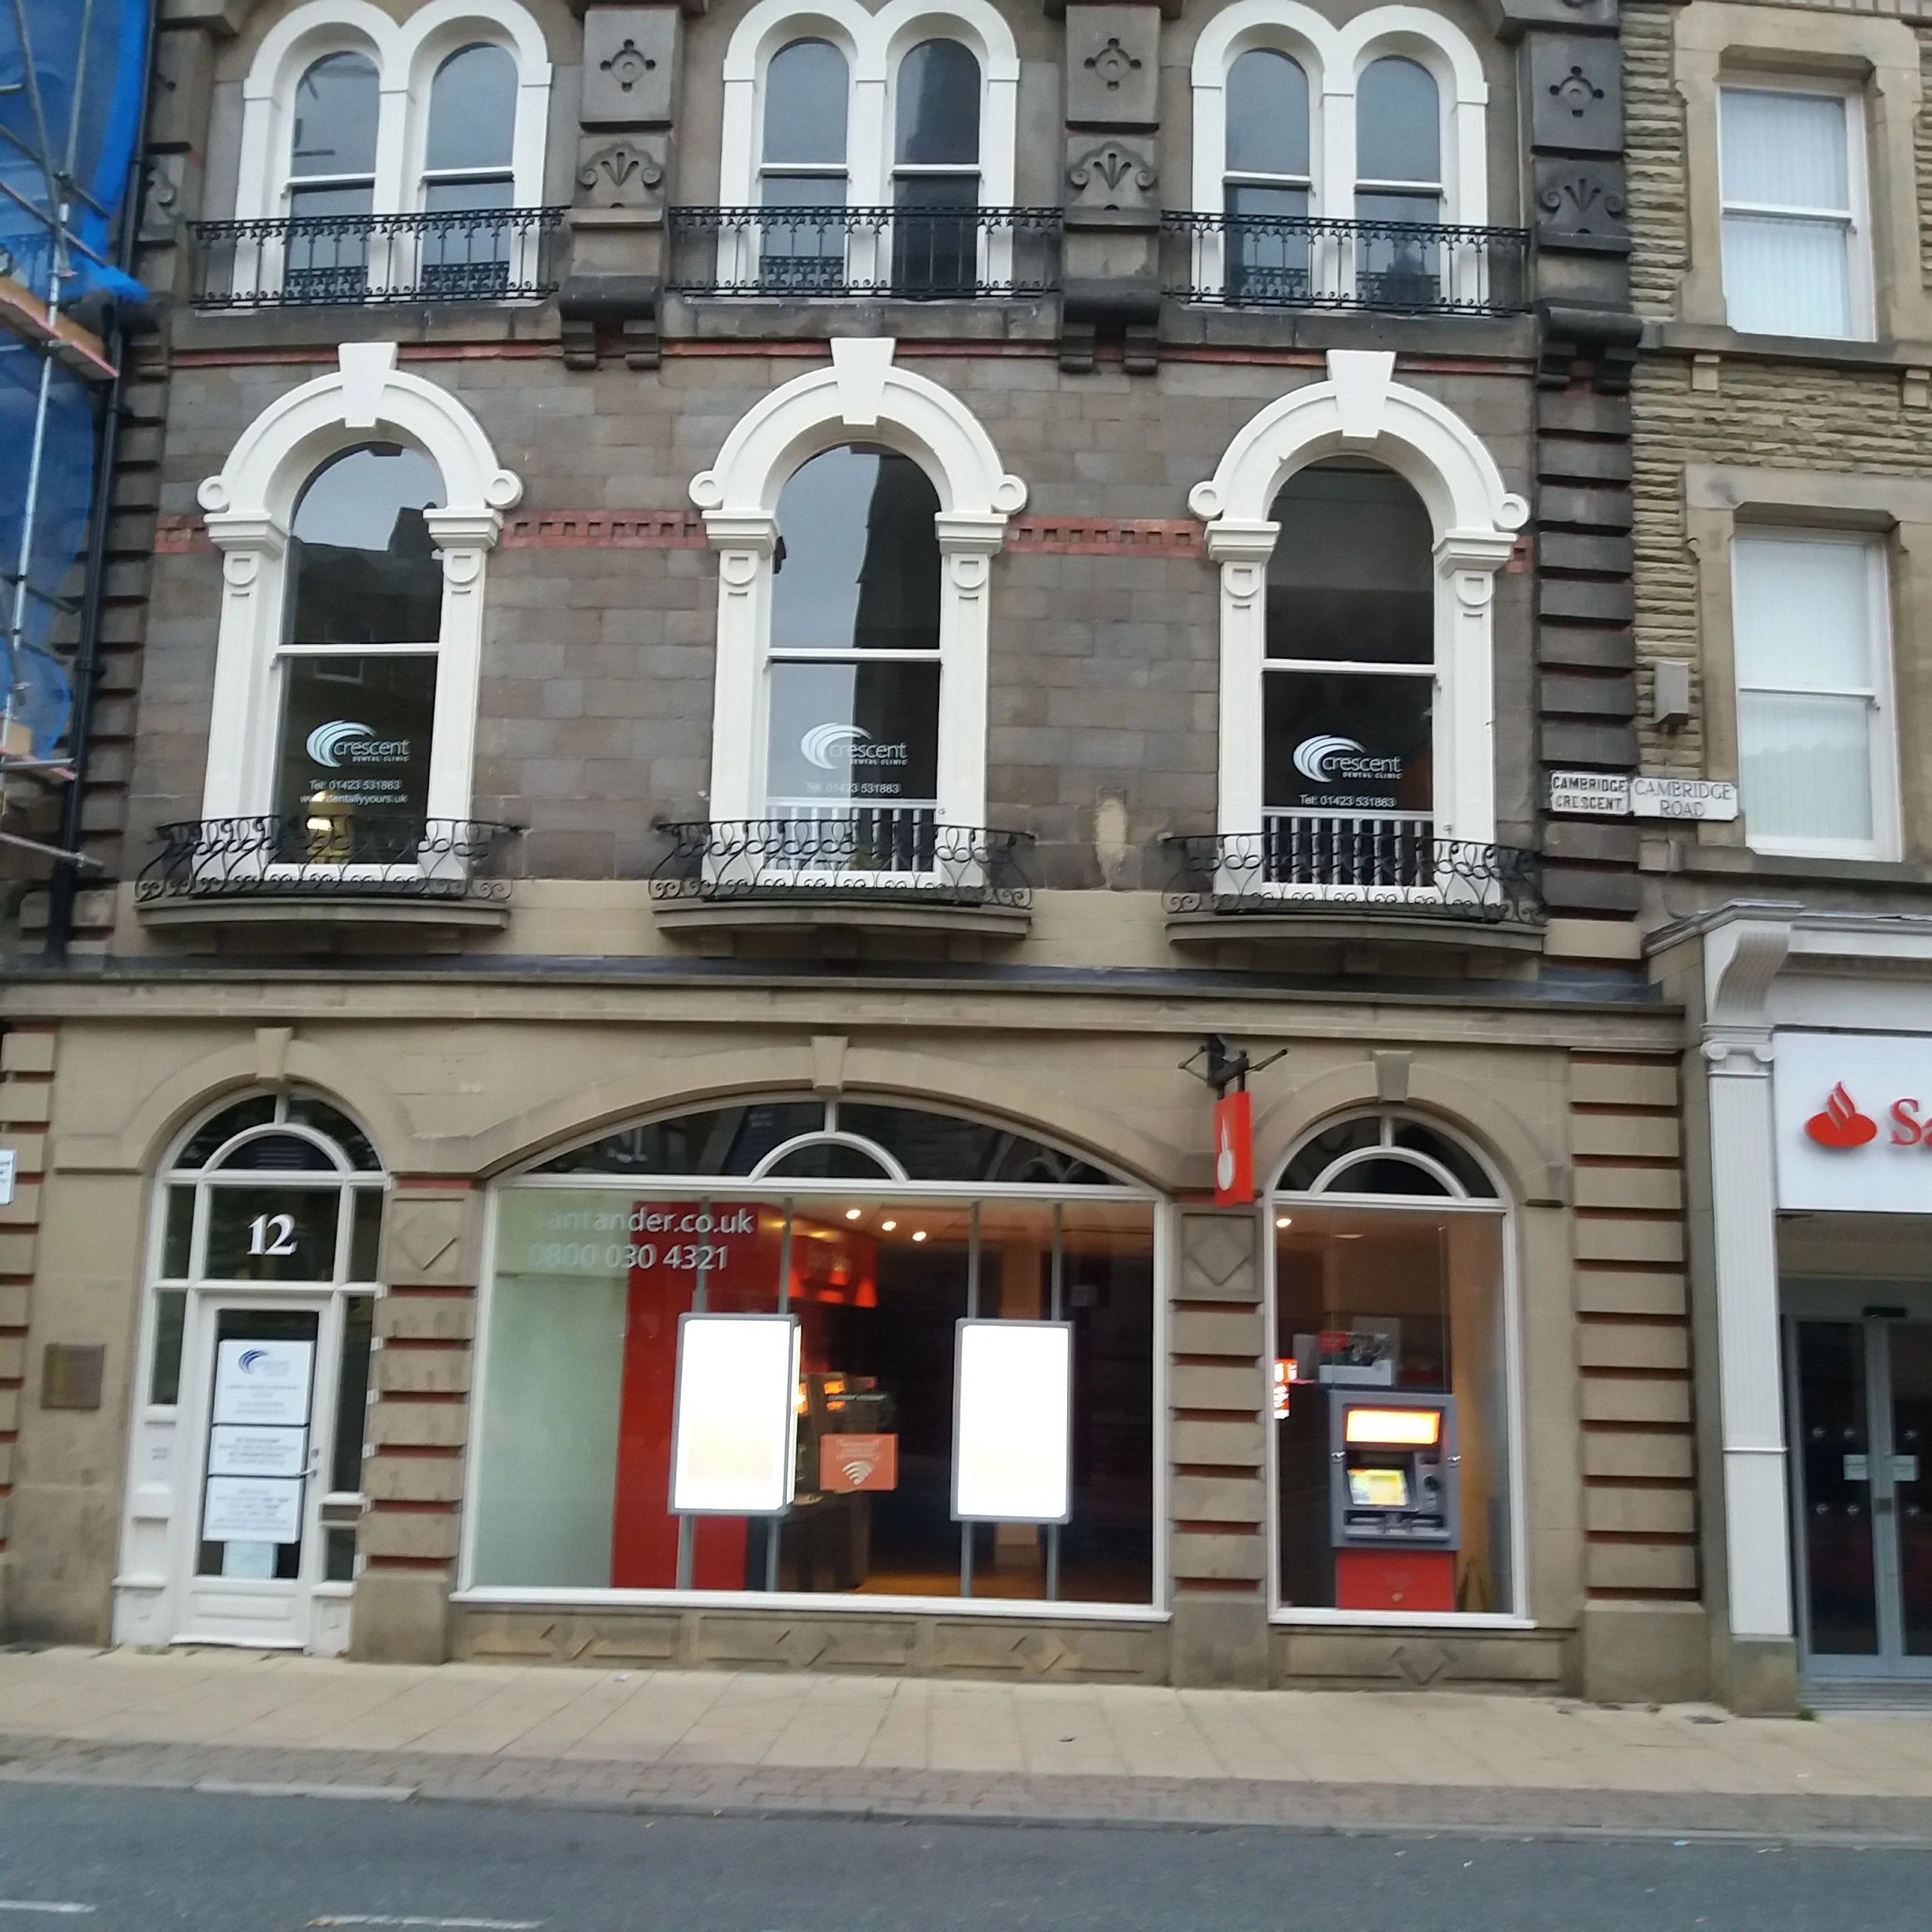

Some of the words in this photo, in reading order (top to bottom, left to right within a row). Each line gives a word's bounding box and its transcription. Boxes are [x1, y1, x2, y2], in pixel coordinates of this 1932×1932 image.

[334, 739, 410, 755] crescent
[829, 742, 908, 758] crescent
[1322, 756, 1403, 772] crescent
[328, 780, 361, 790] 01423
[1552, 777, 1627, 792] CAMBRIDGE
[1634, 779, 1734, 800] CAMBRIDGE
[1320, 795, 1354, 806] 01423
[1556, 795, 1623, 811] CRESCENT
[1660, 799, 1705, 818] ROAD
[247, 1212, 298, 1256] 12
[606, 1243, 657, 1270] 030
[662, 1244, 728, 1271] 4321
